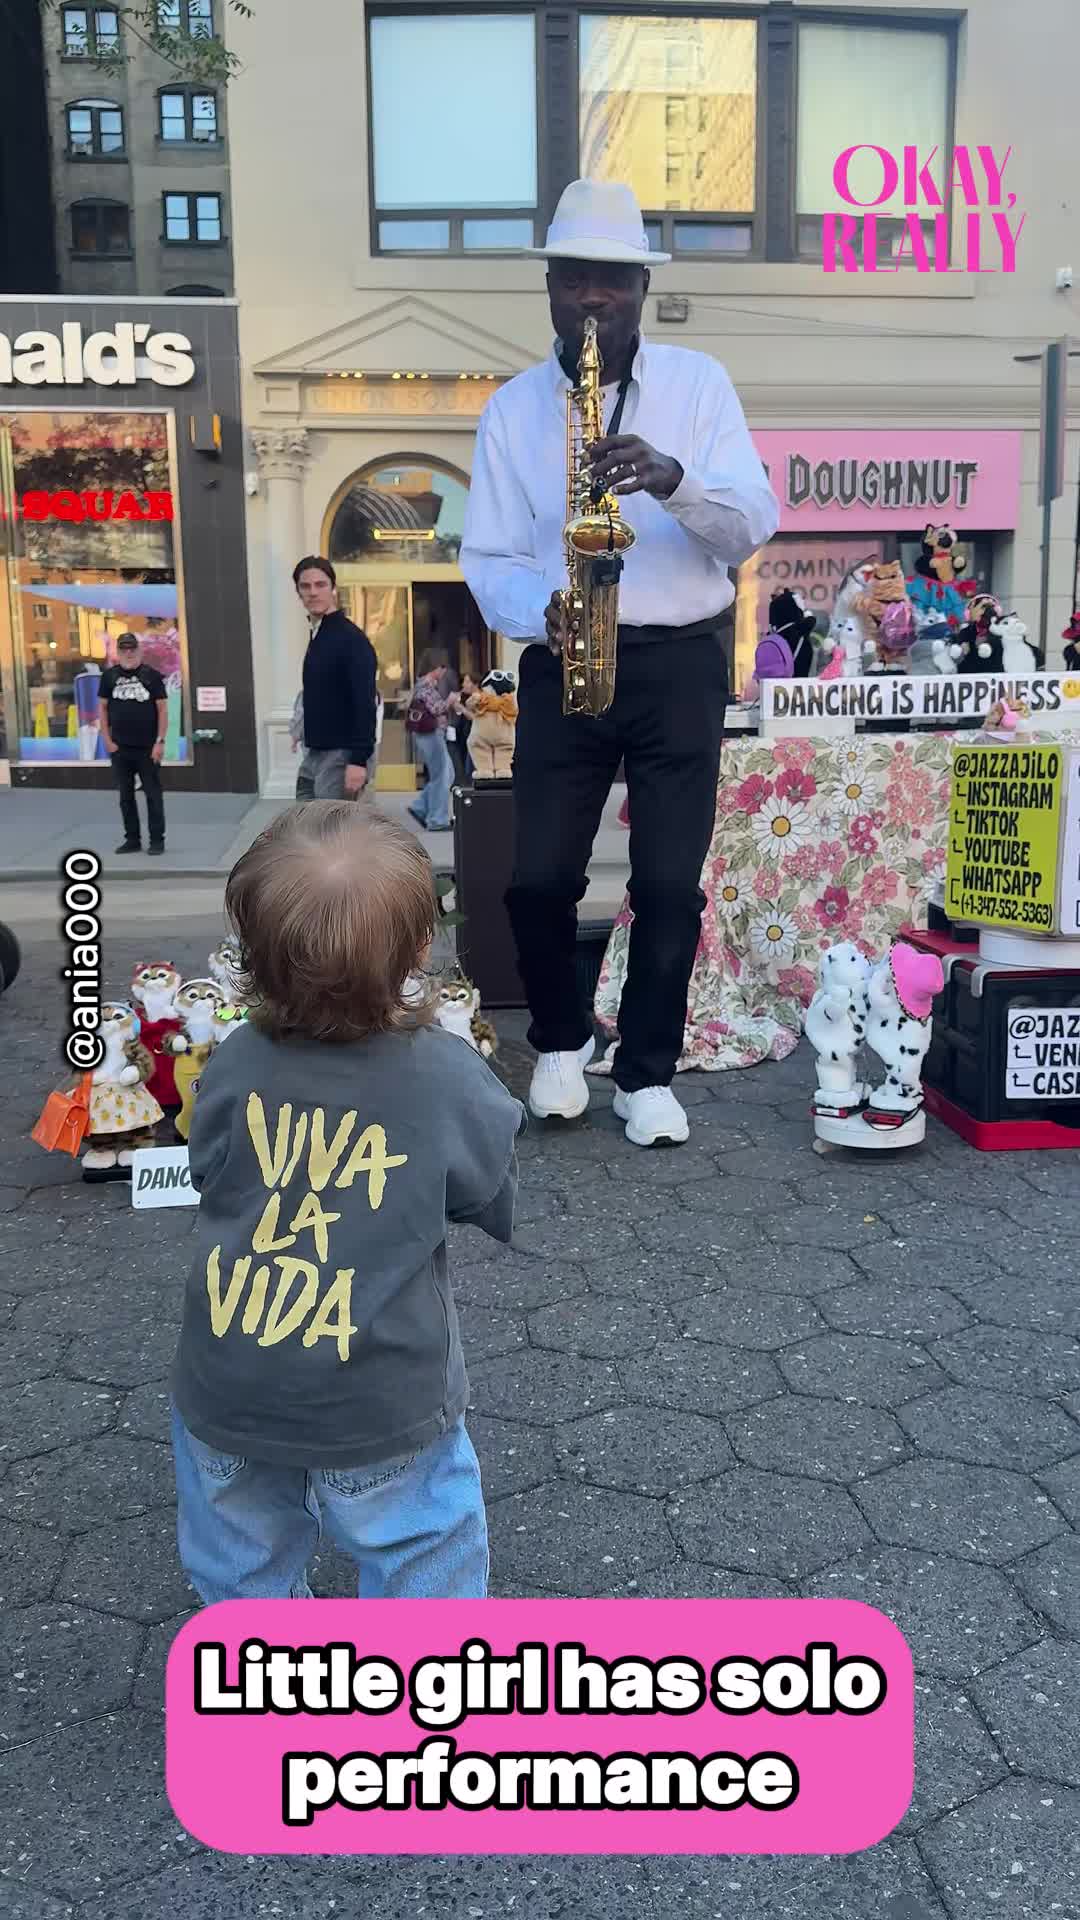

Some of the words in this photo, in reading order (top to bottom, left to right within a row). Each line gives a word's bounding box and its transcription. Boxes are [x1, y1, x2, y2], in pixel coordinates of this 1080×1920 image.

[787, 453, 978, 508] DOUGHNUT
[773, 684, 882, 718] DANCING
[967, 781, 1053, 810] INSTAGRAM
[966, 808, 1020, 837] TIKTOK
[964, 837, 1031, 867] YOUTUBE
[962, 865, 1042, 898] WHATSAPP
[1035, 1043, 1080, 1067] VEN
[246, 1091, 408, 1210] VIVA
[252, 1191, 341, 1264] LA
[206, 1244, 358, 1361] VIDA
